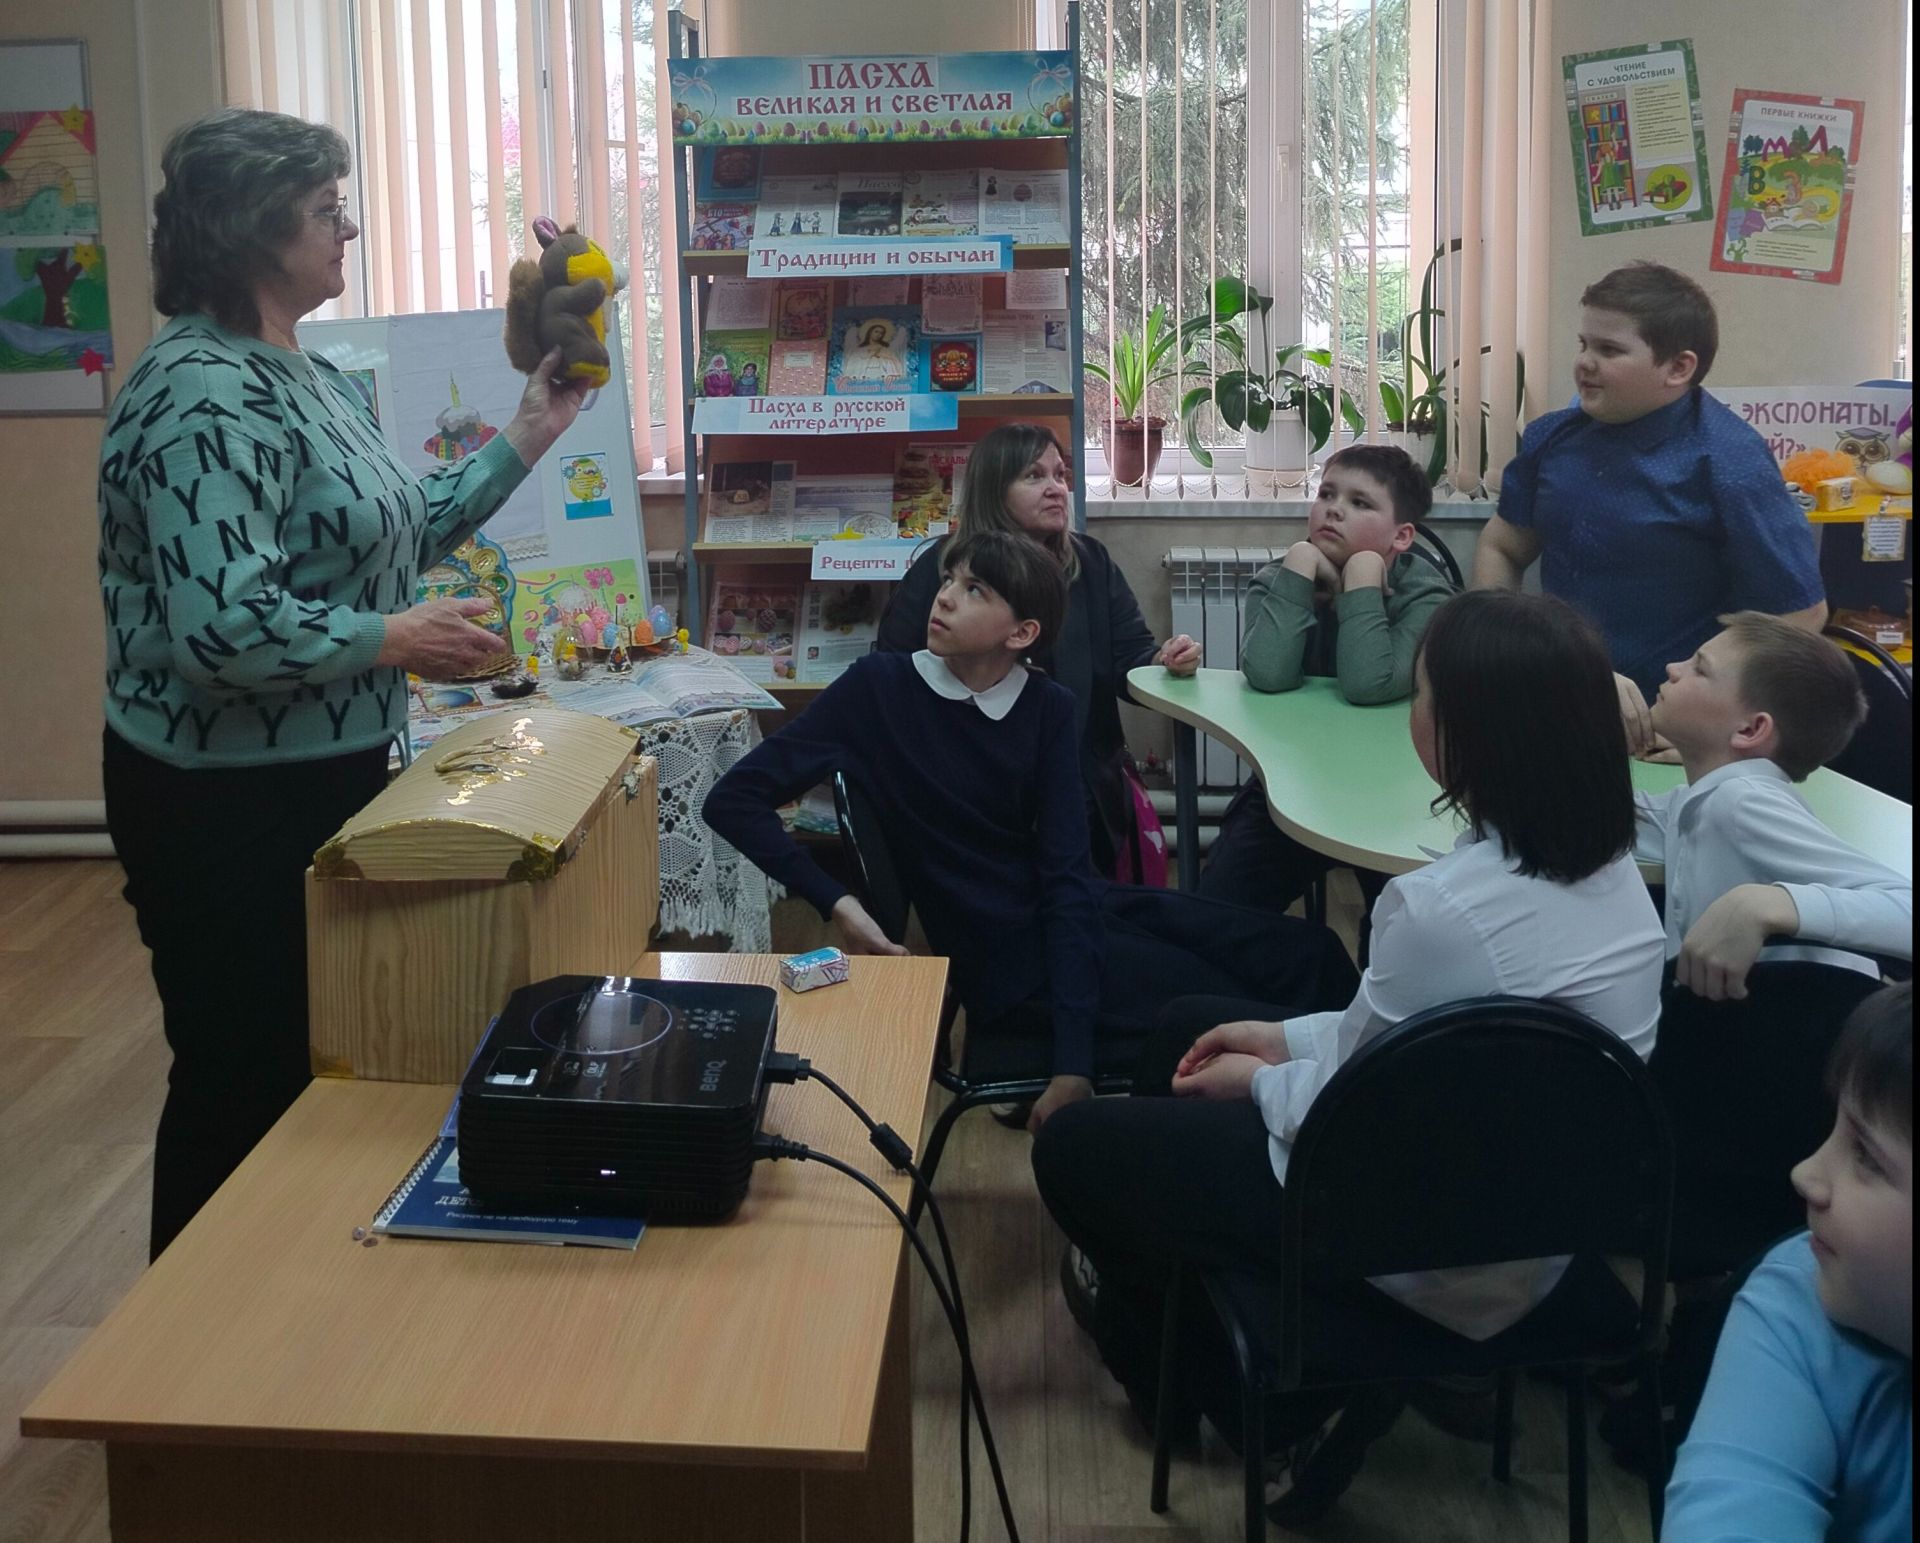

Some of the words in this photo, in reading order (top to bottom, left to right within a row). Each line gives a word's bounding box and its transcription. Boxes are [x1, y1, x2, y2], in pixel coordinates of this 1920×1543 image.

[807, 61, 935, 90] ПАСХА
[1587, 79, 1594, 87] С
[1597, 67, 1675, 86] УДОВОЛЬСТВИЕМ
[1613, 61, 1647, 73] ЧТЕНИЕ
[736, 96, 856, 116] ВЕЛИКАЯ
[865, 95, 881, 114] И
[892, 91, 1013, 114] СВЕТЛАЯ
[1761, 107, 1796, 118] ПЕРВЫЕ
[1798, 111, 1838, 122] КНИЖКИ
[756, 249, 876, 272] Традиции
[887, 251, 900, 265] и
[908, 249, 996, 265] обычаи
[748, 398, 806, 418] Пасха
[813, 401, 824, 412] в
[834, 397, 906, 418] русской
[769, 416, 886, 433] литературе
[195, 427, 231, 474] N
[329, 462, 364, 500] Y
[172, 478, 200, 526] Y
[216, 514, 256, 563] N
[308, 506, 348, 549] N
[158, 534, 191, 589] N
[820, 556, 896, 572] Рецепты
[195, 566, 228, 612] Y
[116, 628, 136, 668] Y
[185, 622, 240, 674] N
[160, 700, 190, 743] Y
[192, 707, 221, 750] Y
[258, 705, 289, 747] Y
[325, 698, 350, 741] Y
[375, 688, 392, 729] Y
